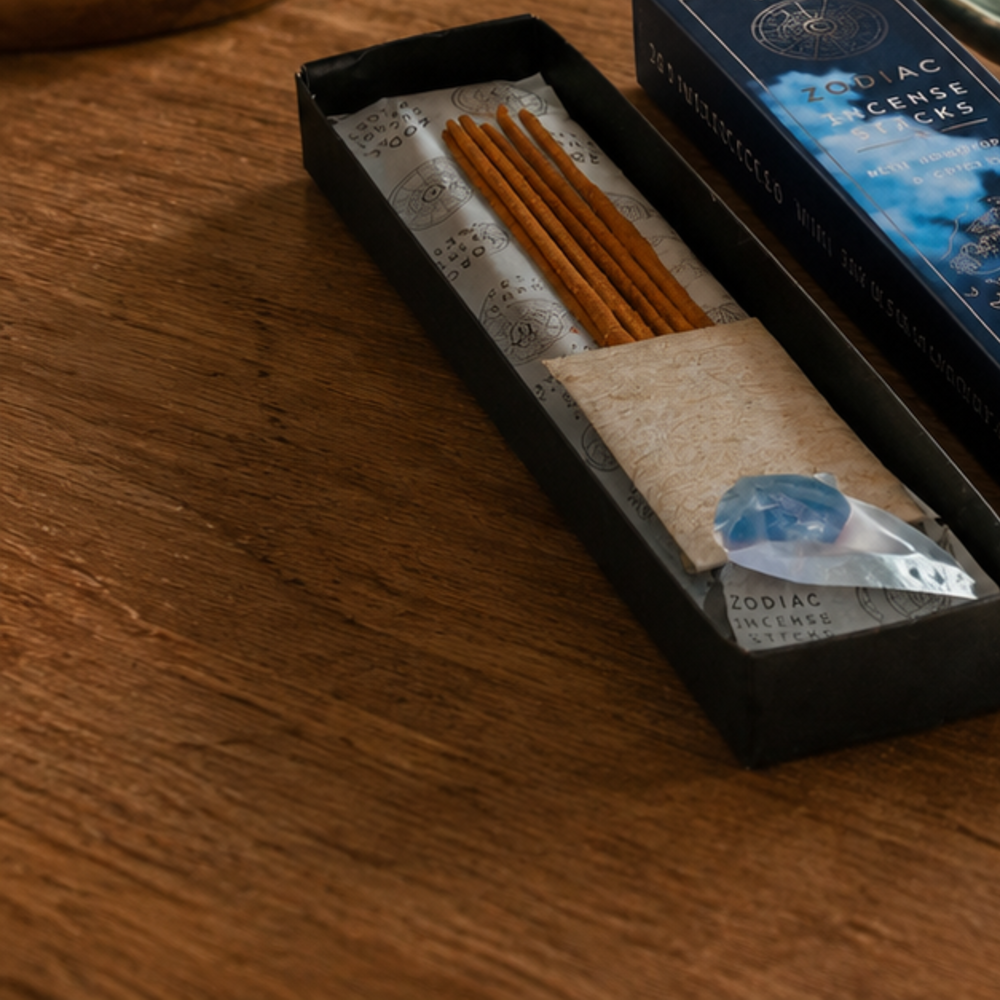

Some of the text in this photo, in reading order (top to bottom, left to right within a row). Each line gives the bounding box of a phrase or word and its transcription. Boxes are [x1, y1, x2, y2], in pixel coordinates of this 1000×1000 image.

[802, 59, 941, 103] ZODIAC
[822, 82, 968, 126] INCENSE
[730, 593, 821, 610] ZODIAC
